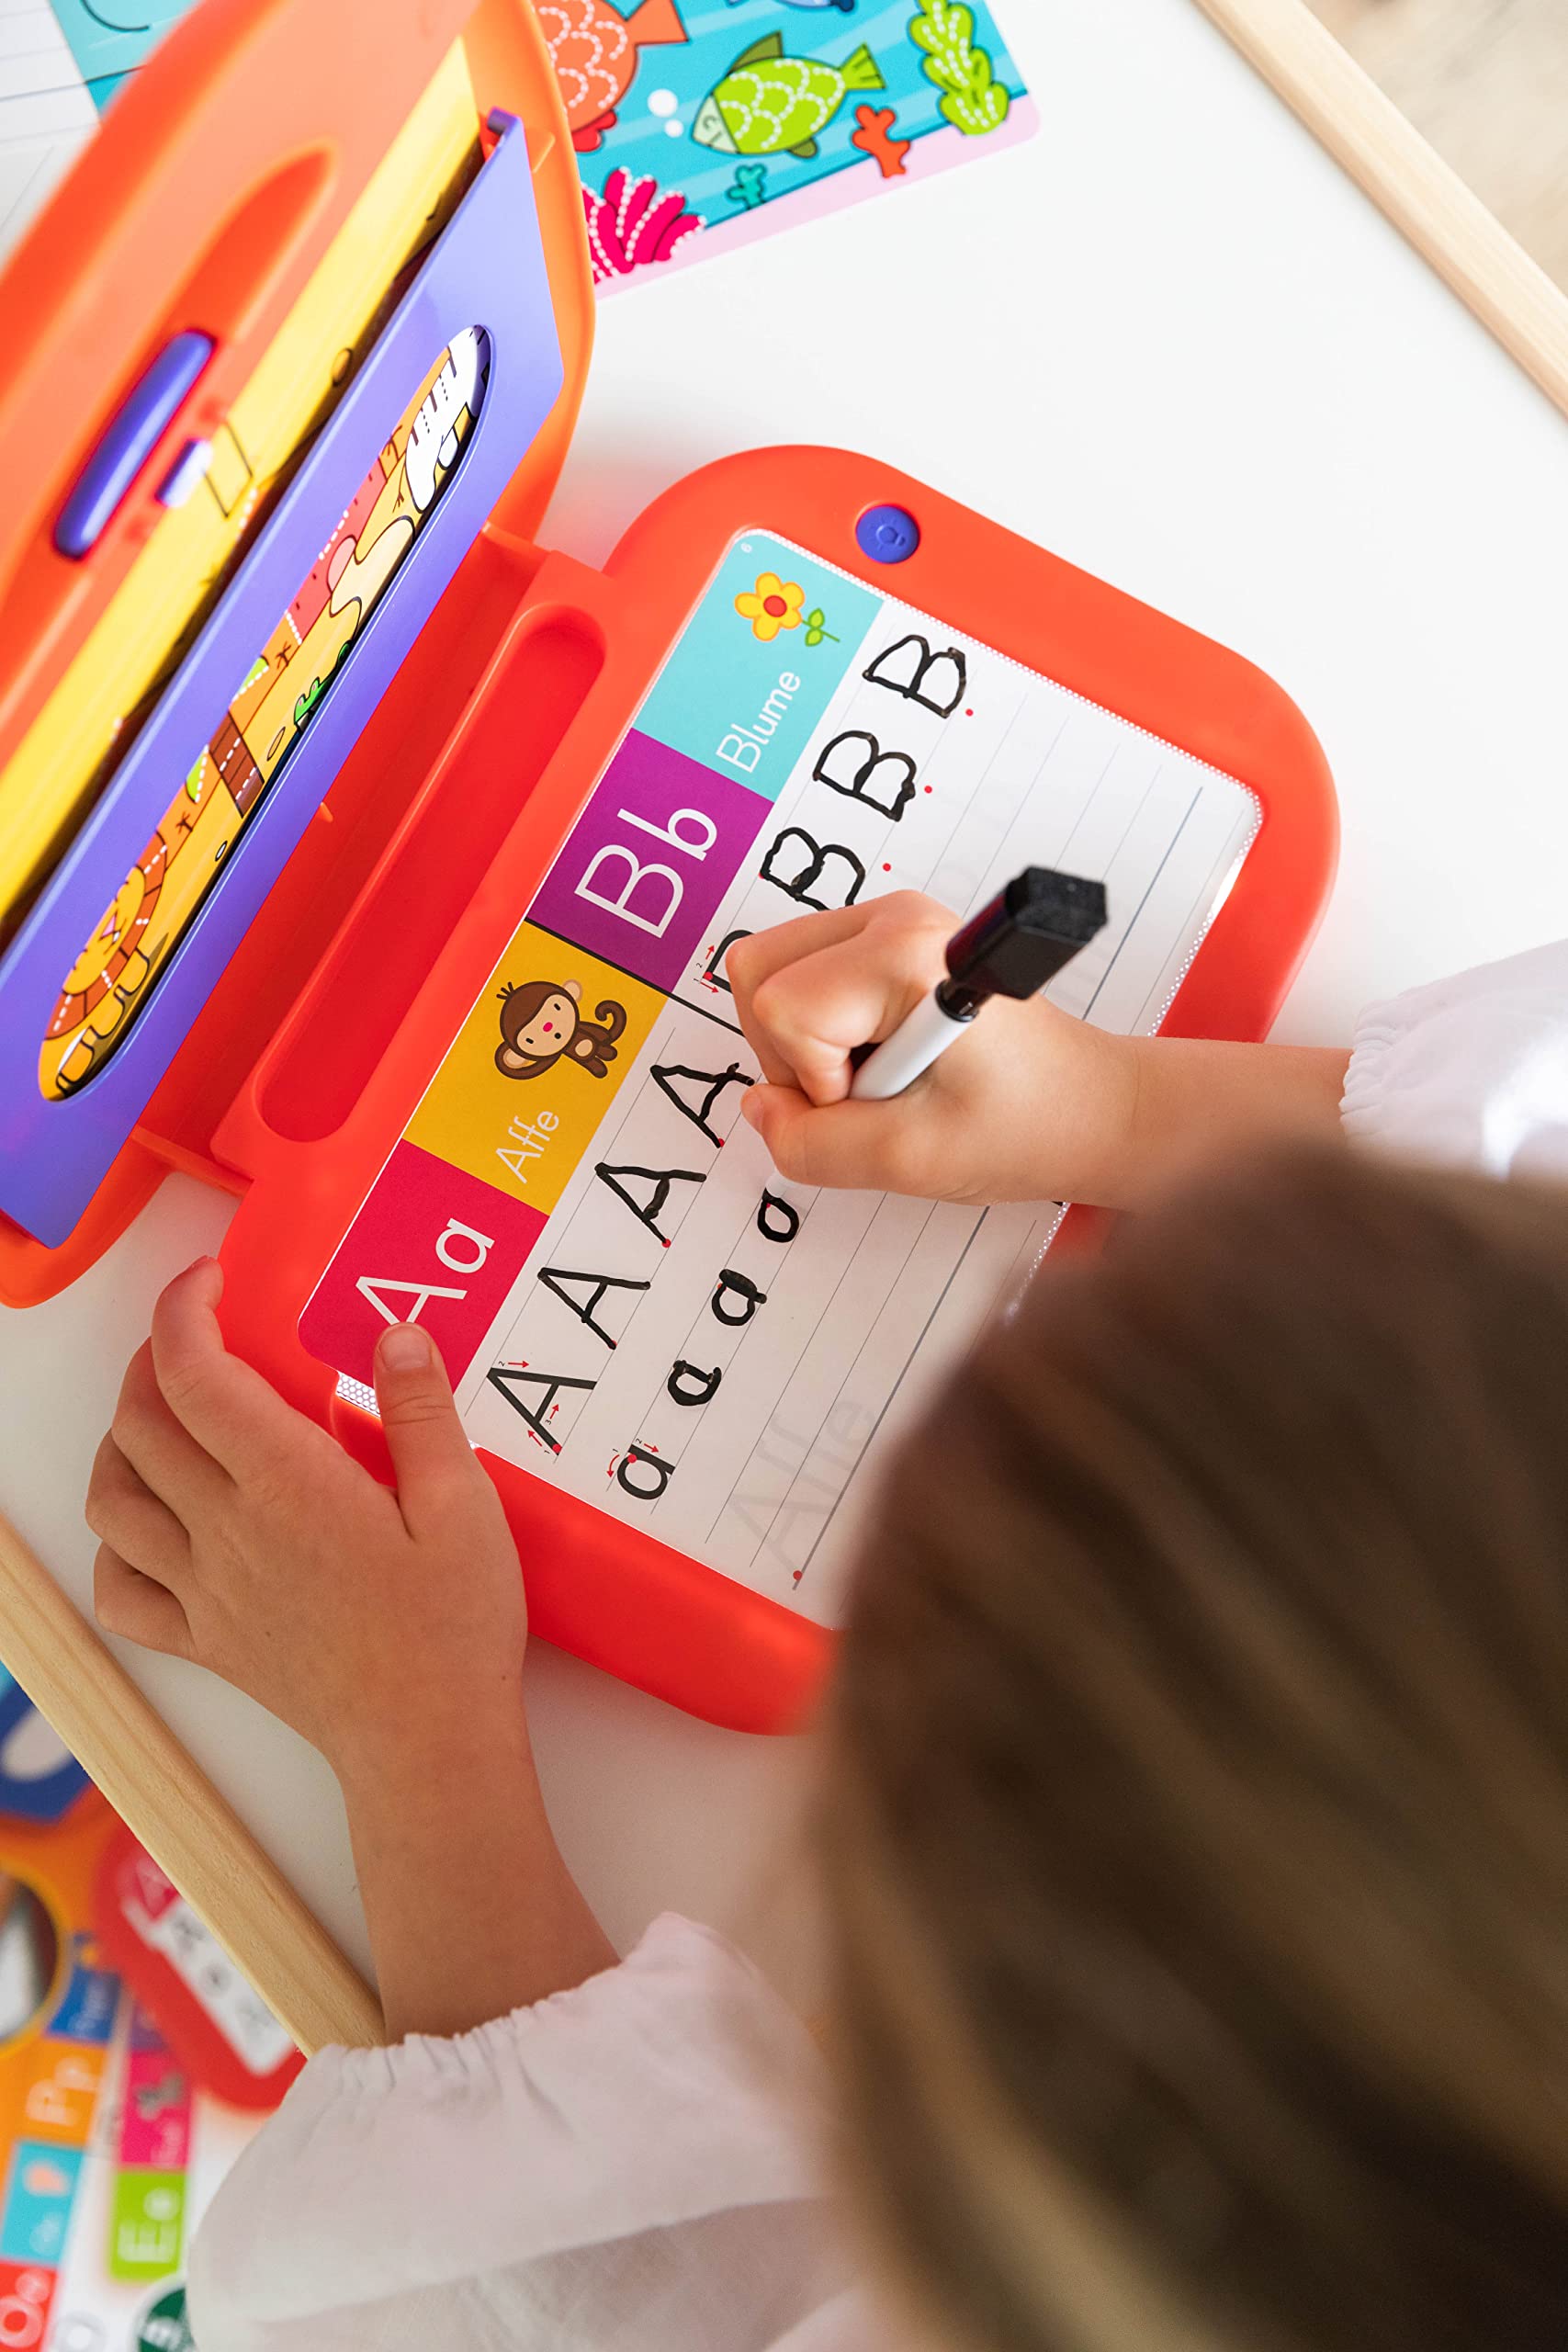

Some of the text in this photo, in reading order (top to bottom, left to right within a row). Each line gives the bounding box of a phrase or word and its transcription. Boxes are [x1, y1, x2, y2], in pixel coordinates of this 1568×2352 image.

[716, 671, 801, 773] Blume
[759, 634, 966, 911] B B B
[574, 808, 717, 938] Bb
[495, 1111, 559, 1184] Affe
[537, 1267, 651, 1350] A
[594, 1162, 706, 1244] A
[650, 1062, 755, 1148] A
[355, 1214, 495, 1326] Aa
[667, 1360, 722, 1406] a
[712, 1269, 767, 1326] a
[486, 1367, 598, 1456] A
[617, 1444, 676, 1500] a
